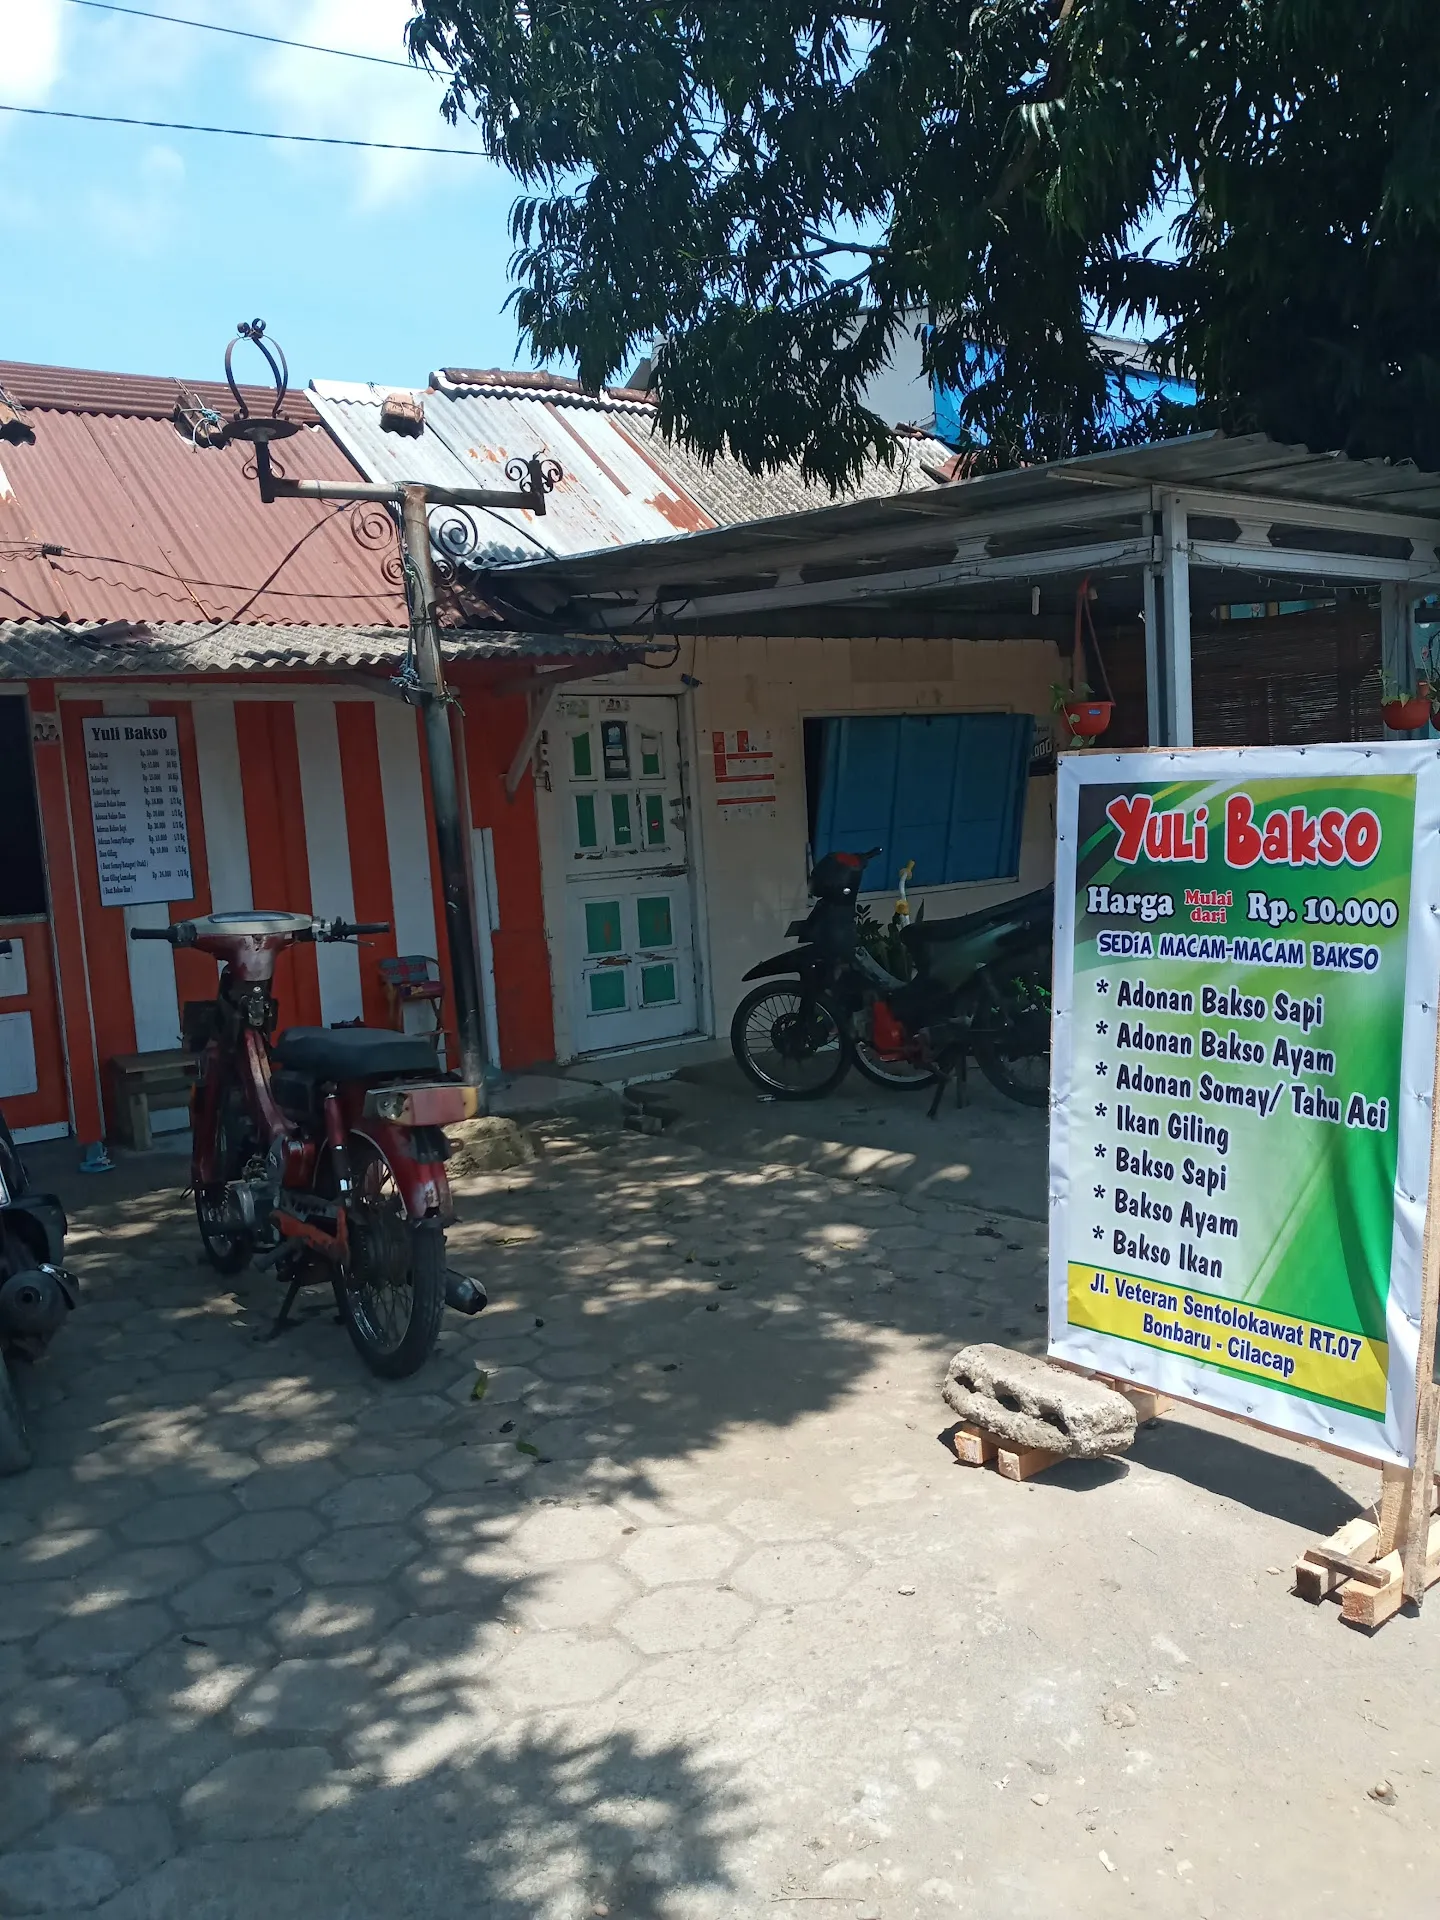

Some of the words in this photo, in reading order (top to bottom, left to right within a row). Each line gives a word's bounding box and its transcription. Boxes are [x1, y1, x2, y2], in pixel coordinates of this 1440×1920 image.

[124, 727, 167, 740] Bakso
[1226, 794, 1379, 867] Bakso
[1087, 887, 1174, 921] Harga
[1185, 890, 1232, 906] Mulai
[1247, 893, 1296, 925] Rp.
[1303, 898, 1397, 926] 10.000
[1191, 907, 1227, 923] dari
[1160, 936, 1303, 965] MACAM-MACAM
[1313, 944, 1379, 970] BAKSO
[1117, 980, 1192, 1012] Adonan
[1202, 987, 1265, 1018] Bakso
[1274, 993, 1322, 1031] Sapi
[1117, 1022, 1192, 1054] Adonan
[1201, 1030, 1264, 1063] Bakso
[1272, 1038, 1333, 1076] Ayam
[1116, 1065, 1191, 1097] Adonan
[1200, 1074, 1284, 1117] Somay/
[1292, 1086, 1339, 1121] Tahu
[1348, 1096, 1388, 1128] Aci
[1117, 1105, 1159, 1135] Ikan
[1168, 1113, 1229, 1154] Giling
[1116, 1147, 1174, 1181] Bakso
[1182, 1158, 1226, 1196] Sapi
[1115, 1188, 1172, 1223] Bakso
[1180, 1201, 1238, 1238] Ayam
[1113, 1230, 1170, 1265] Bakso
[1179, 1243, 1222, 1278] Ikan
[1090, 1273, 1109, 1295] Jl.
[1115, 1278, 1177, 1312] Veteran
[1183, 1295, 1303, 1346] Sentolokawat
[1309, 1329, 1362, 1362] RT.07
[1143, 1313, 1211, 1350] Bonbaru
[1228, 1337, 1294, 1377] Cilacap
